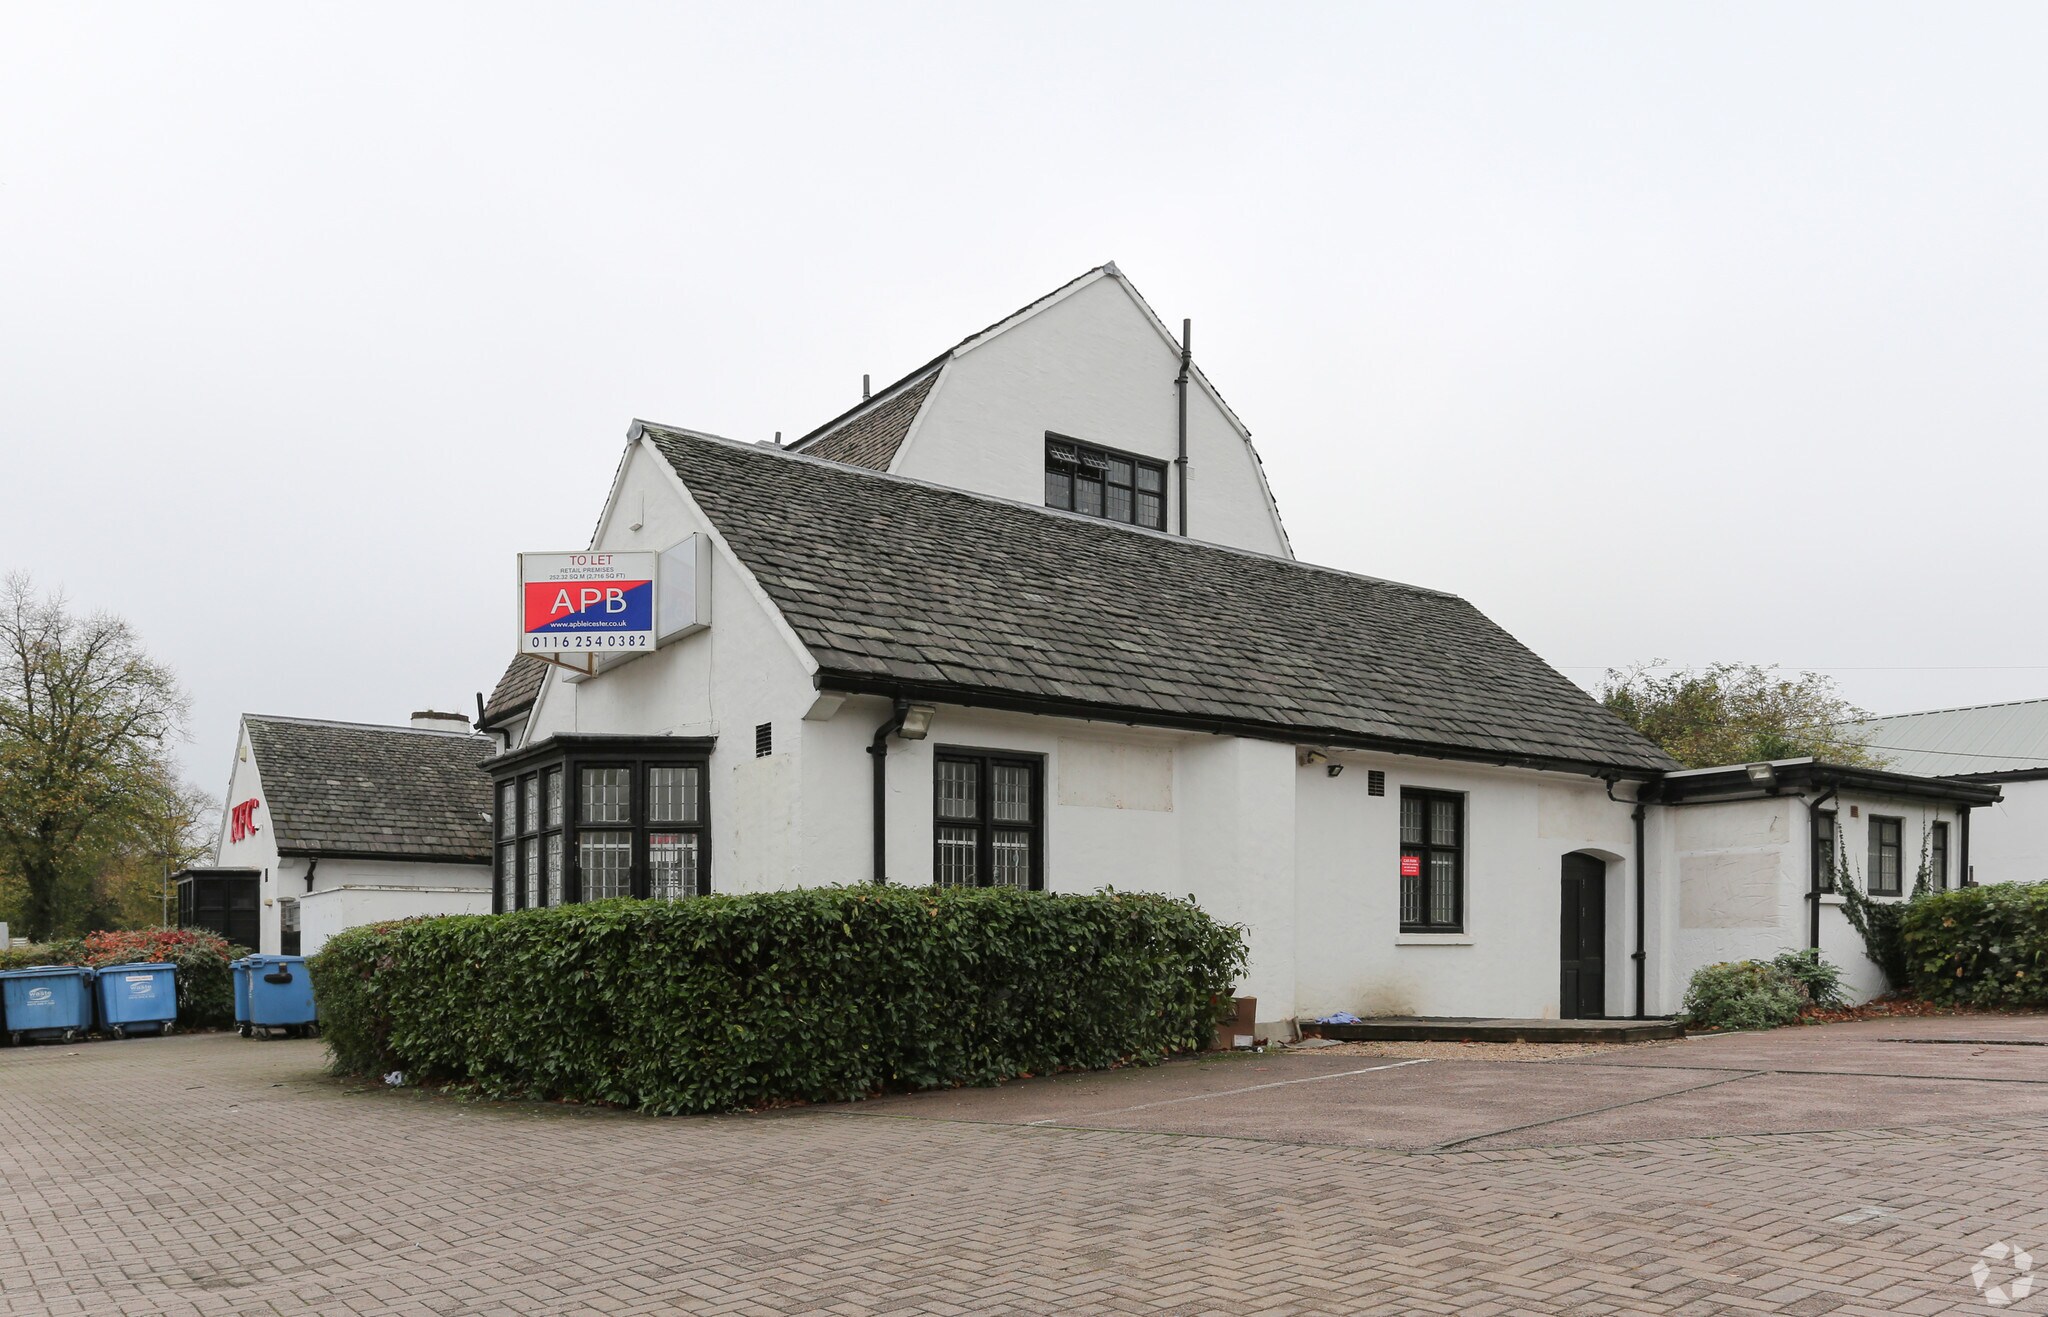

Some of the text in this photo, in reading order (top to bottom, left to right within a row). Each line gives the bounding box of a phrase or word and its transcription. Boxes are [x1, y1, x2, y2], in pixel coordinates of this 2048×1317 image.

[569, 554, 614, 566] TO LET
[550, 587, 627, 615] APB
[550, 620, 627, 629] www.apbleicester.co.uk
[532, 635, 646, 648] 0116 254 0382
[230, 797, 260, 844] KFC
